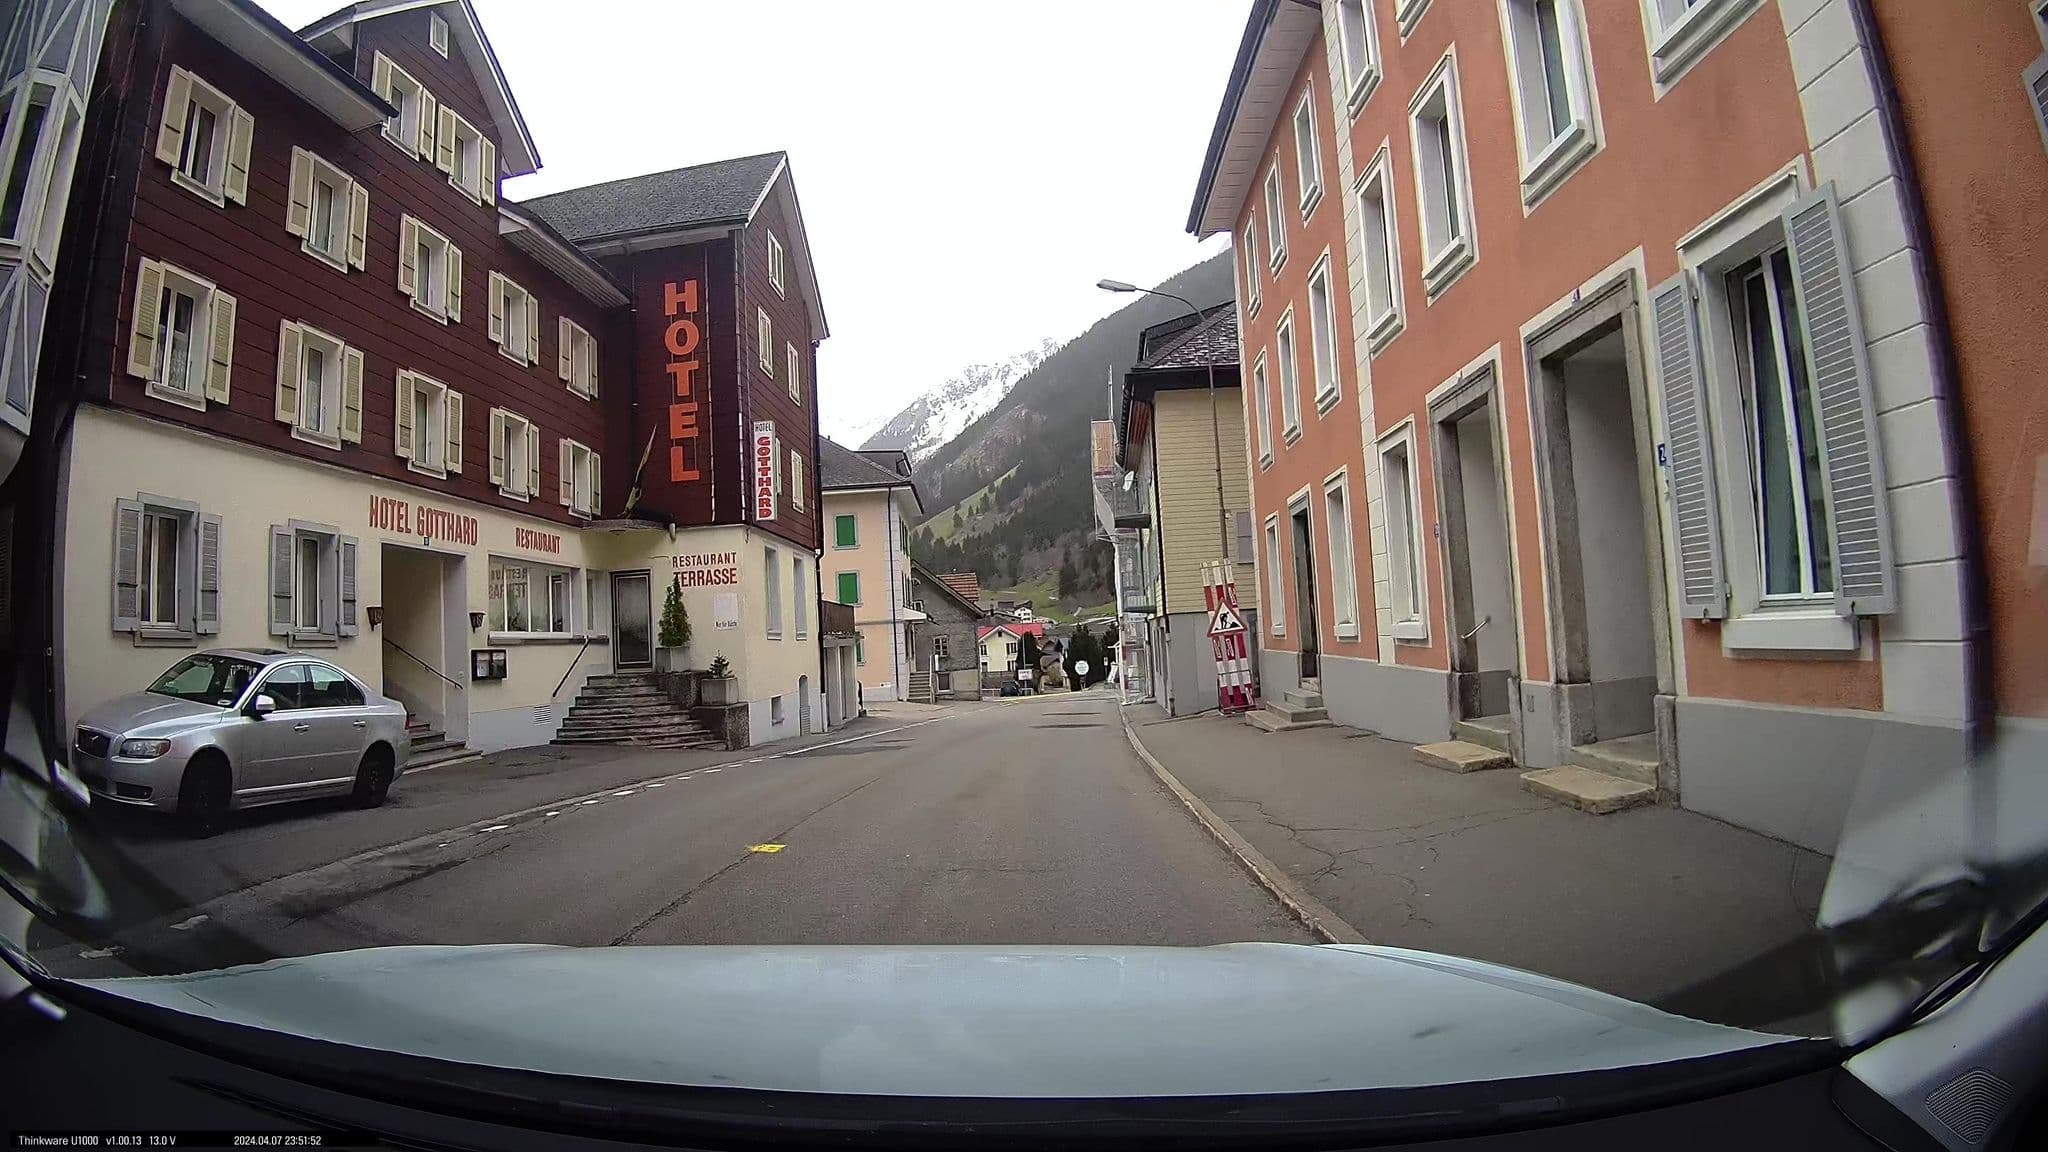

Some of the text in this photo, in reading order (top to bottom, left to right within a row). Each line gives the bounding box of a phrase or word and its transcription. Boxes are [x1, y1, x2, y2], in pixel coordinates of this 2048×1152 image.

[664, 280, 700, 482] HOTEL
[755, 423, 772, 432] HOTEL
[757, 437, 772, 518] GOTTHARD
[369, 495, 478, 546] HOTEL GOTTHARD
[515, 527, 561, 554] RESTAURANT
[672, 552, 737, 568] RESTAURANT
[673, 568, 738, 587] TERRASSE
